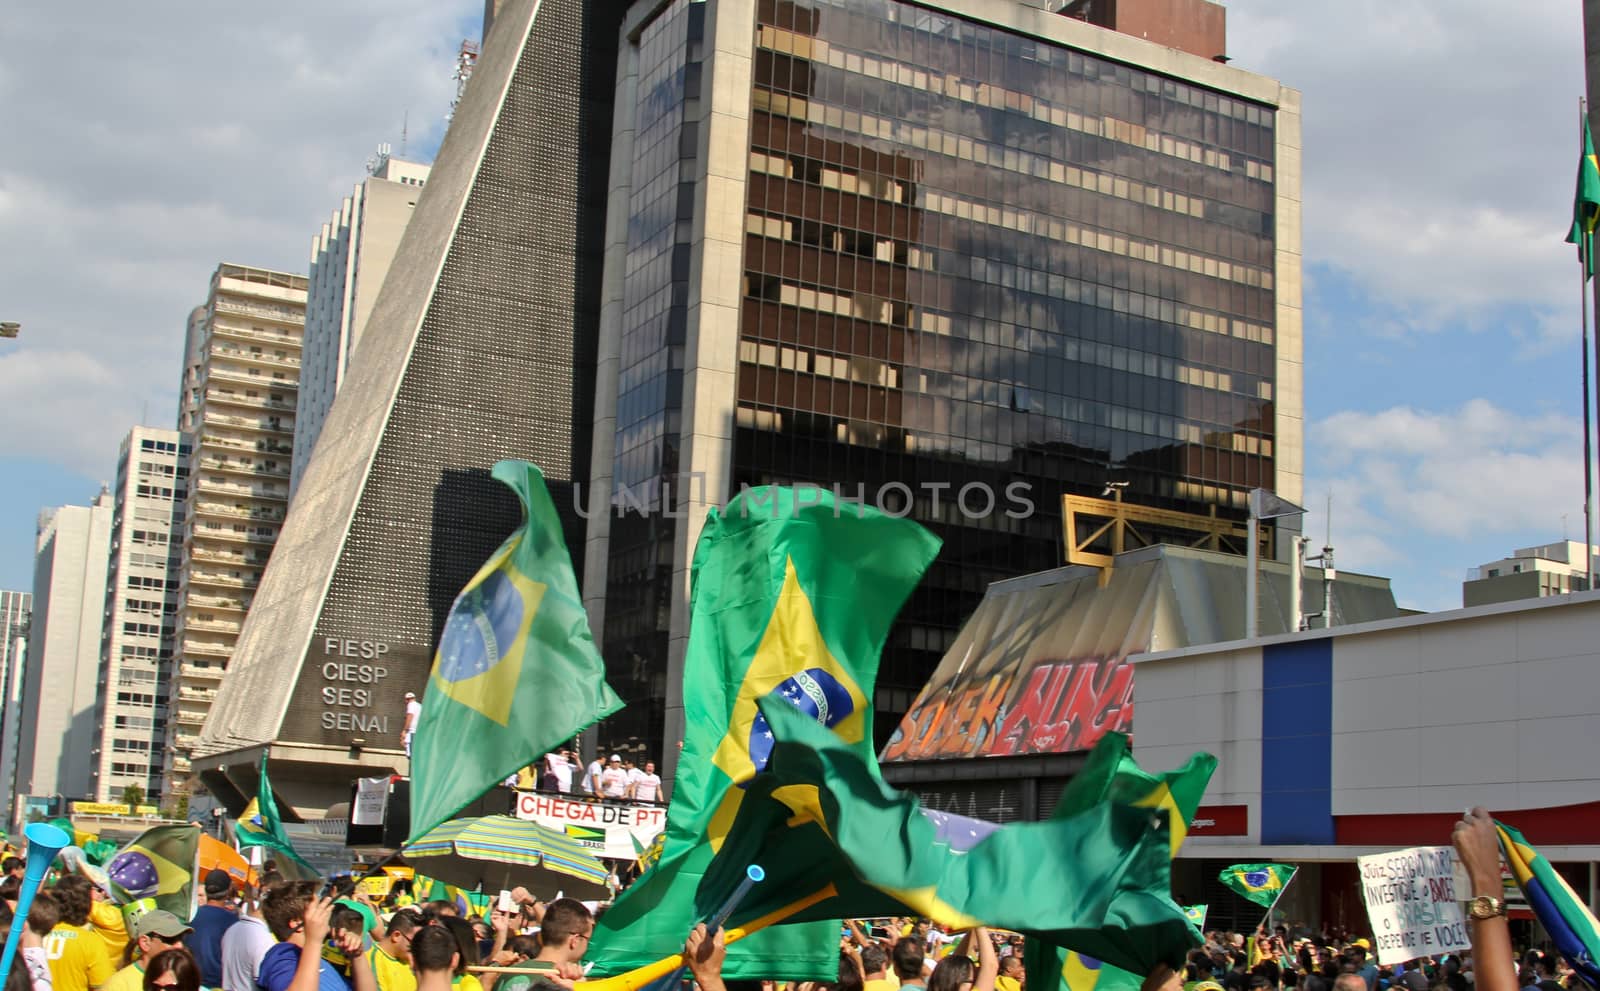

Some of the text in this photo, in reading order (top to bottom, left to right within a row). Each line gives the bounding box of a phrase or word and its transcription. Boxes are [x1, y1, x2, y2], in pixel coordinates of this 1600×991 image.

[325, 638, 389, 659] FIESP
[323, 662, 388, 683] CIESP
[323, 687, 372, 707] SESI
[322, 712, 388, 733] SENAI
[521, 796, 662, 826] CHEGA DE PT
[583, 841, 606, 850] BRASIL
[1396, 902, 1449, 929] BRASIL
